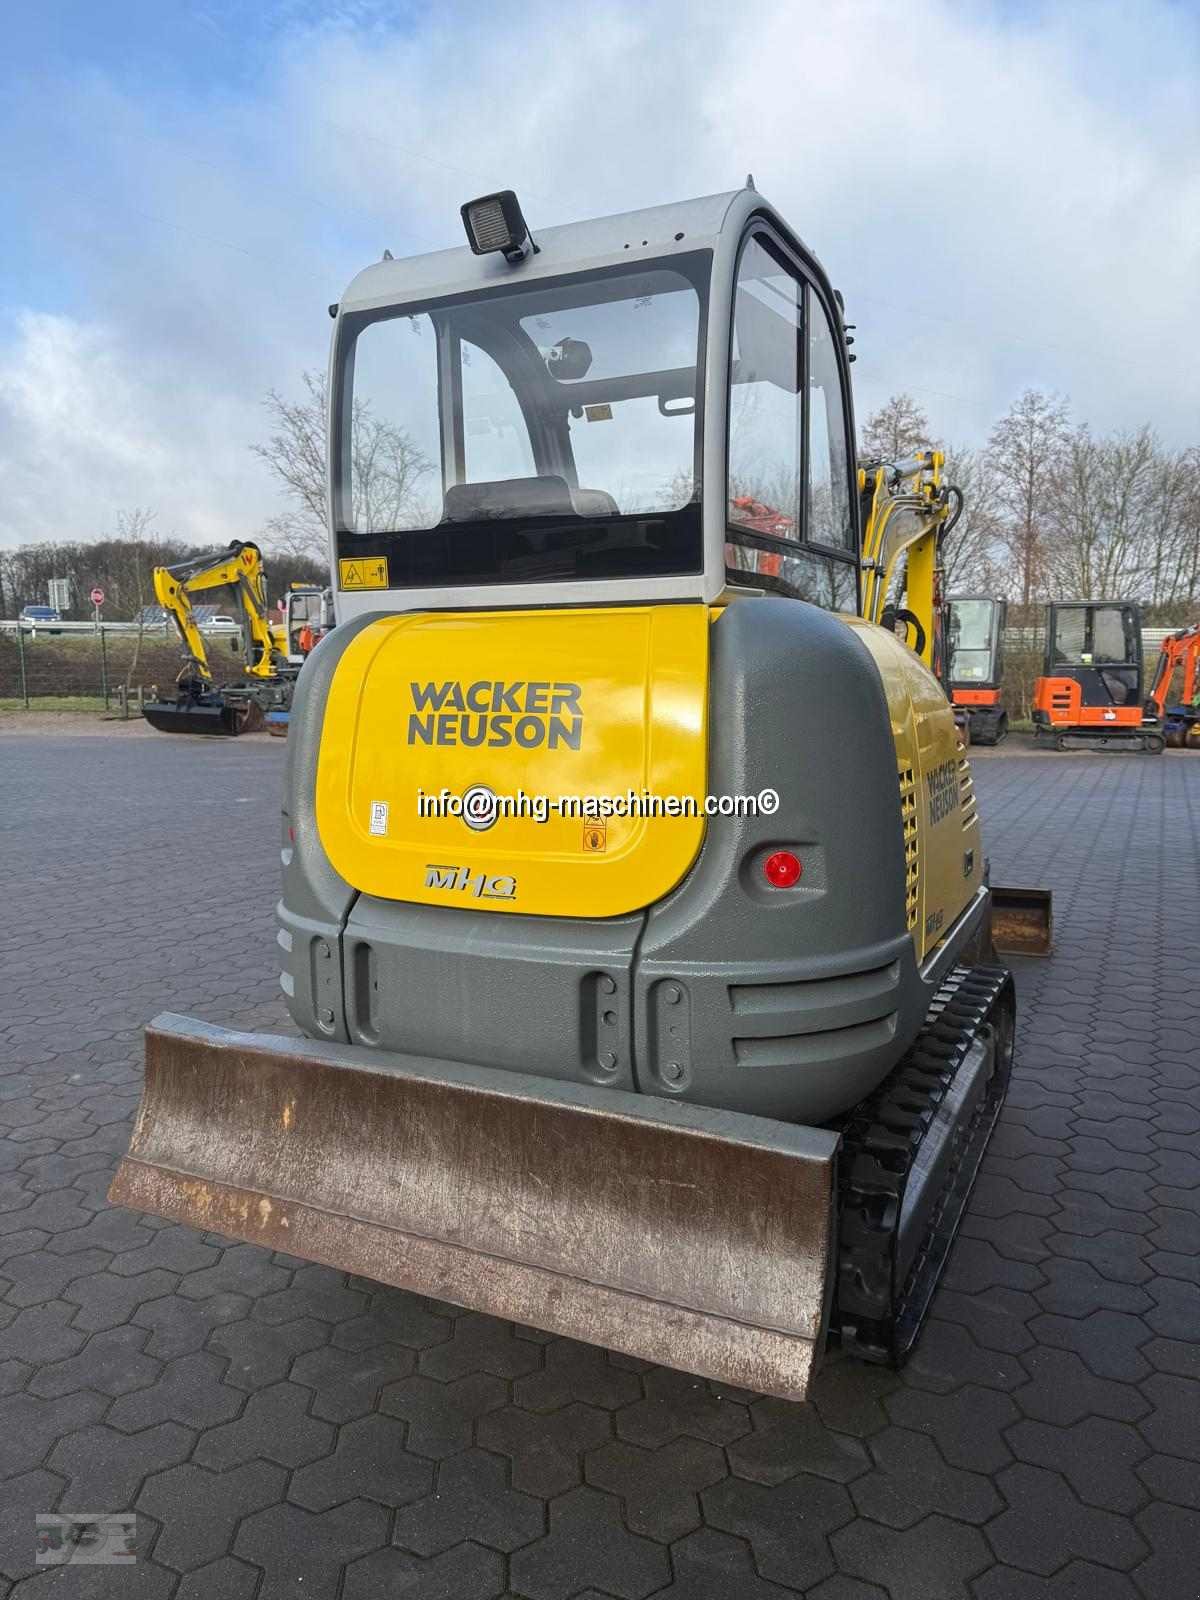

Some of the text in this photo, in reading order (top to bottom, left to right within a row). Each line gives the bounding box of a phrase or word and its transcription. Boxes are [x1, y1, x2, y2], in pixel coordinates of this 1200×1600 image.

[411, 681, 582, 713] WACKER
[407, 714, 582, 750] NEUSON
[425, 864, 517, 900] MHG
